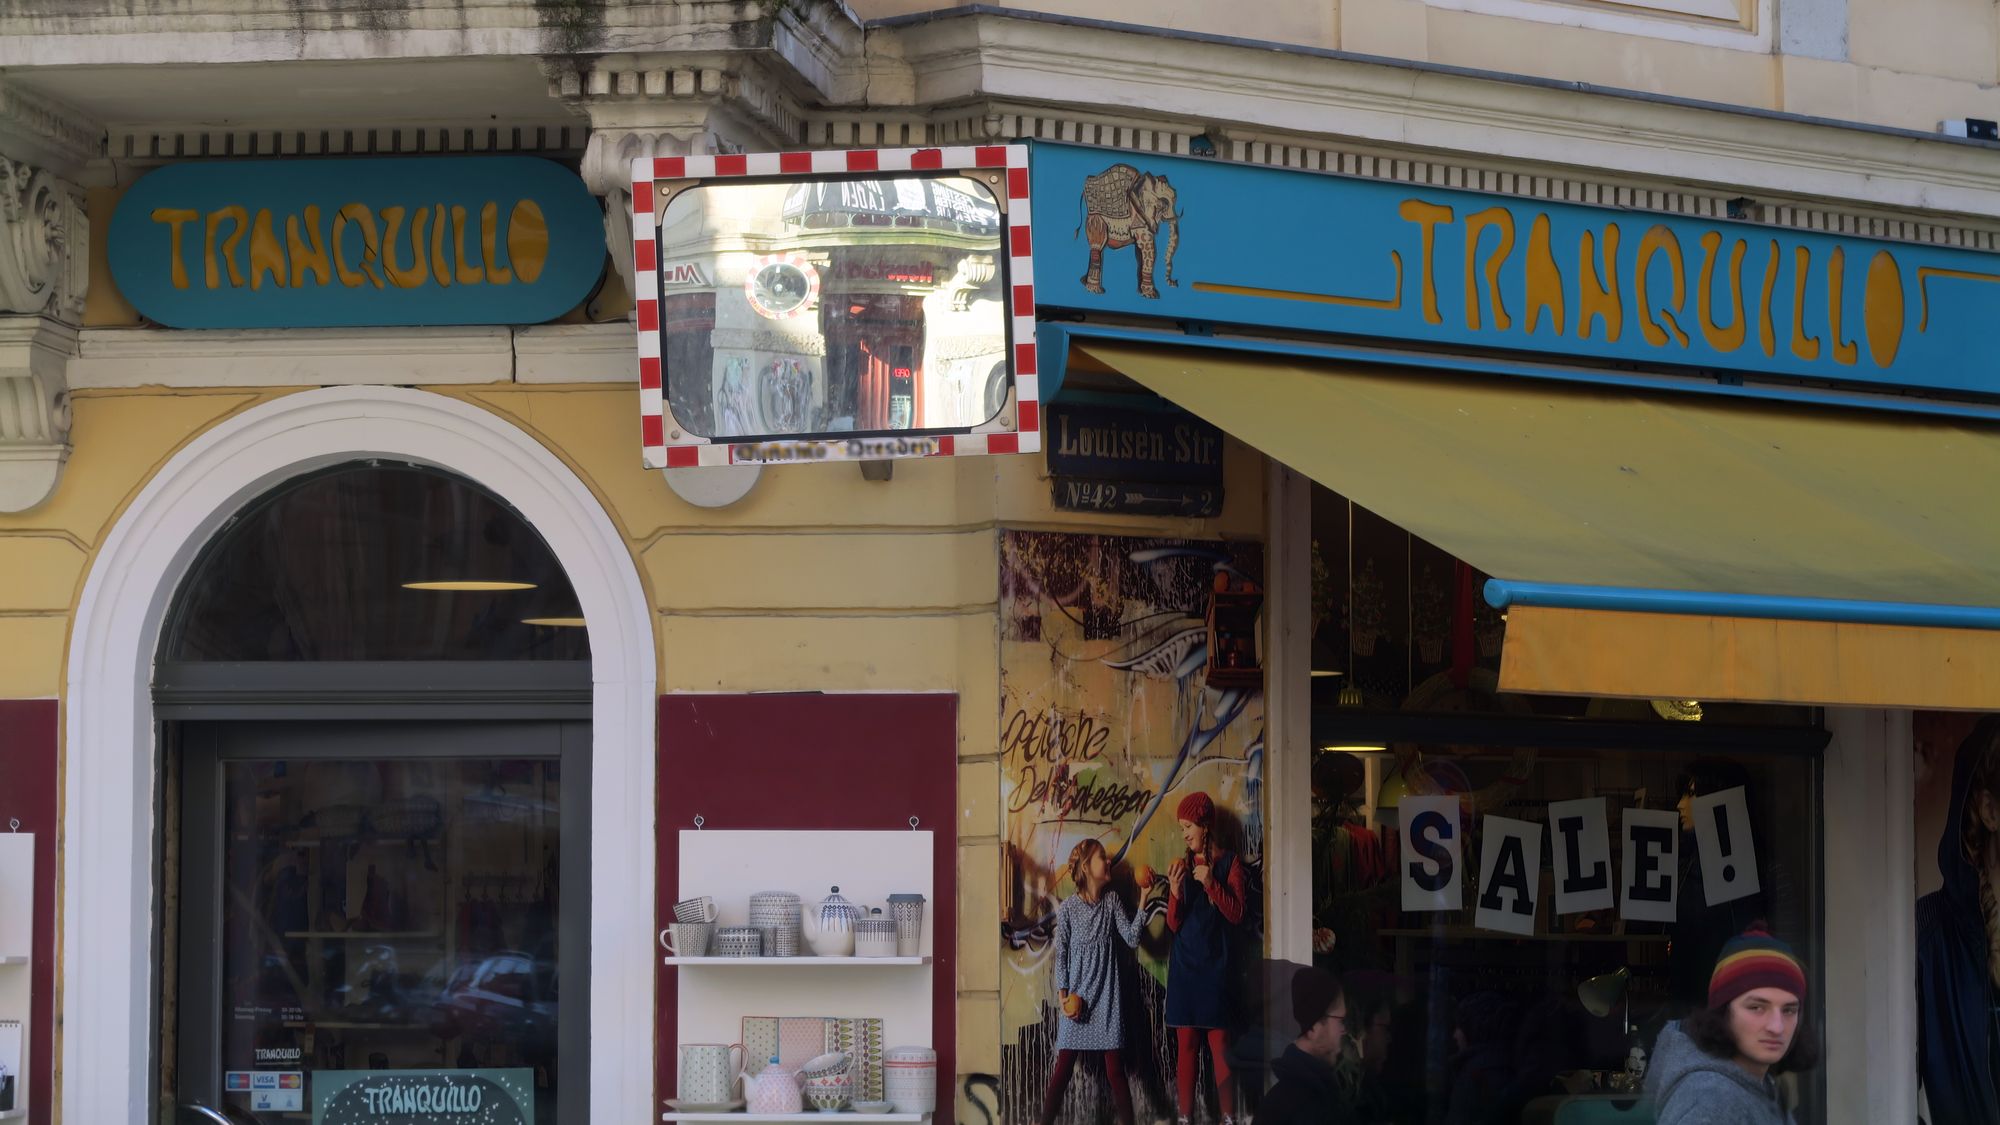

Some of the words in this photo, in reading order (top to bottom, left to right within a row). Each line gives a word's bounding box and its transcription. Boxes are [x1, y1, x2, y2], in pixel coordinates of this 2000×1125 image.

[151, 199, 549, 290] TRANQUILLO
[1400, 198, 1904, 369] TRANQUILLO
[1200, 490, 1213, 514] 2
[255, 1048, 301, 1060] TRANQUILLO
[256, 1075, 275, 1084] VISA
[364, 1084, 482, 1115] TRANQUILLO
